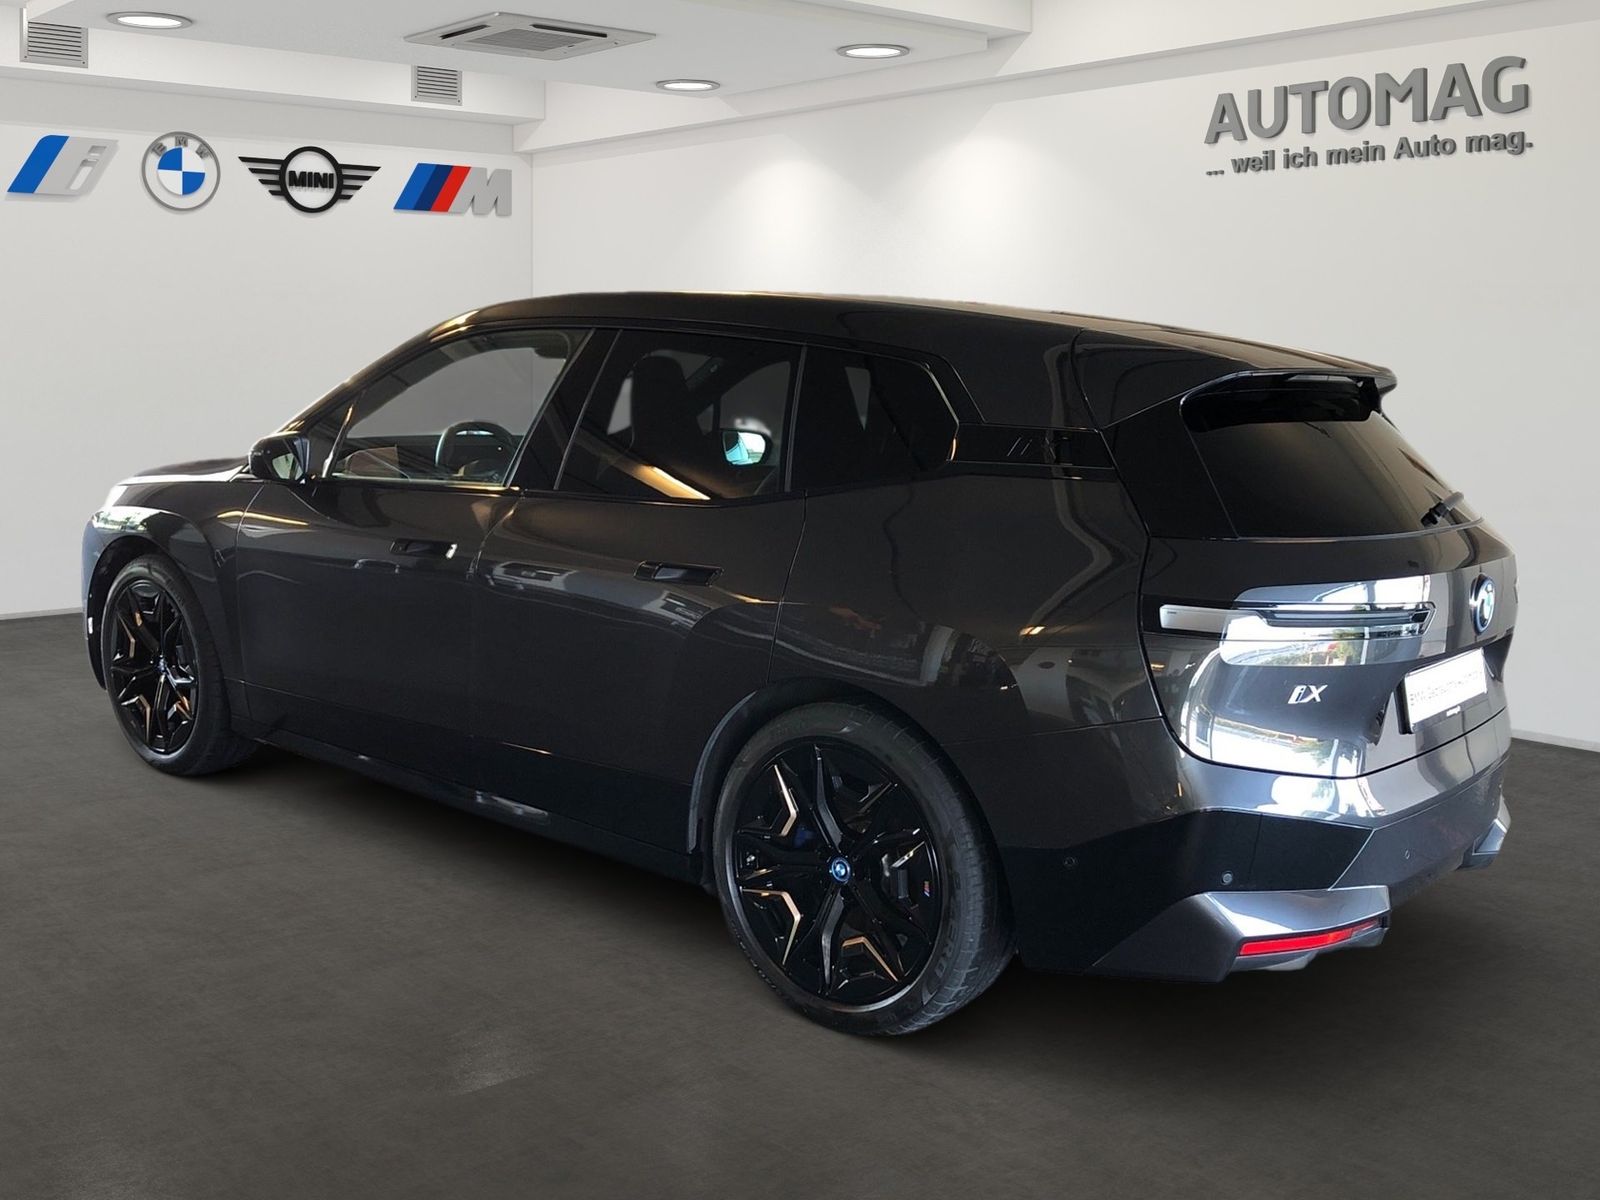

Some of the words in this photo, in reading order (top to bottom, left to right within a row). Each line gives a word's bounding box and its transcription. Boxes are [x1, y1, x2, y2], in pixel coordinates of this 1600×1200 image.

[1204, 56, 1529, 144] AUTOMAG
[1231, 150, 1275, 173] weil
[1283, 147, 1318, 167] ich
[1326, 140, 1385, 165] mein
[1394, 134, 1457, 159] Auto
[1465, 131, 1533, 155] mag.
[288, 169, 335, 190] MINI
